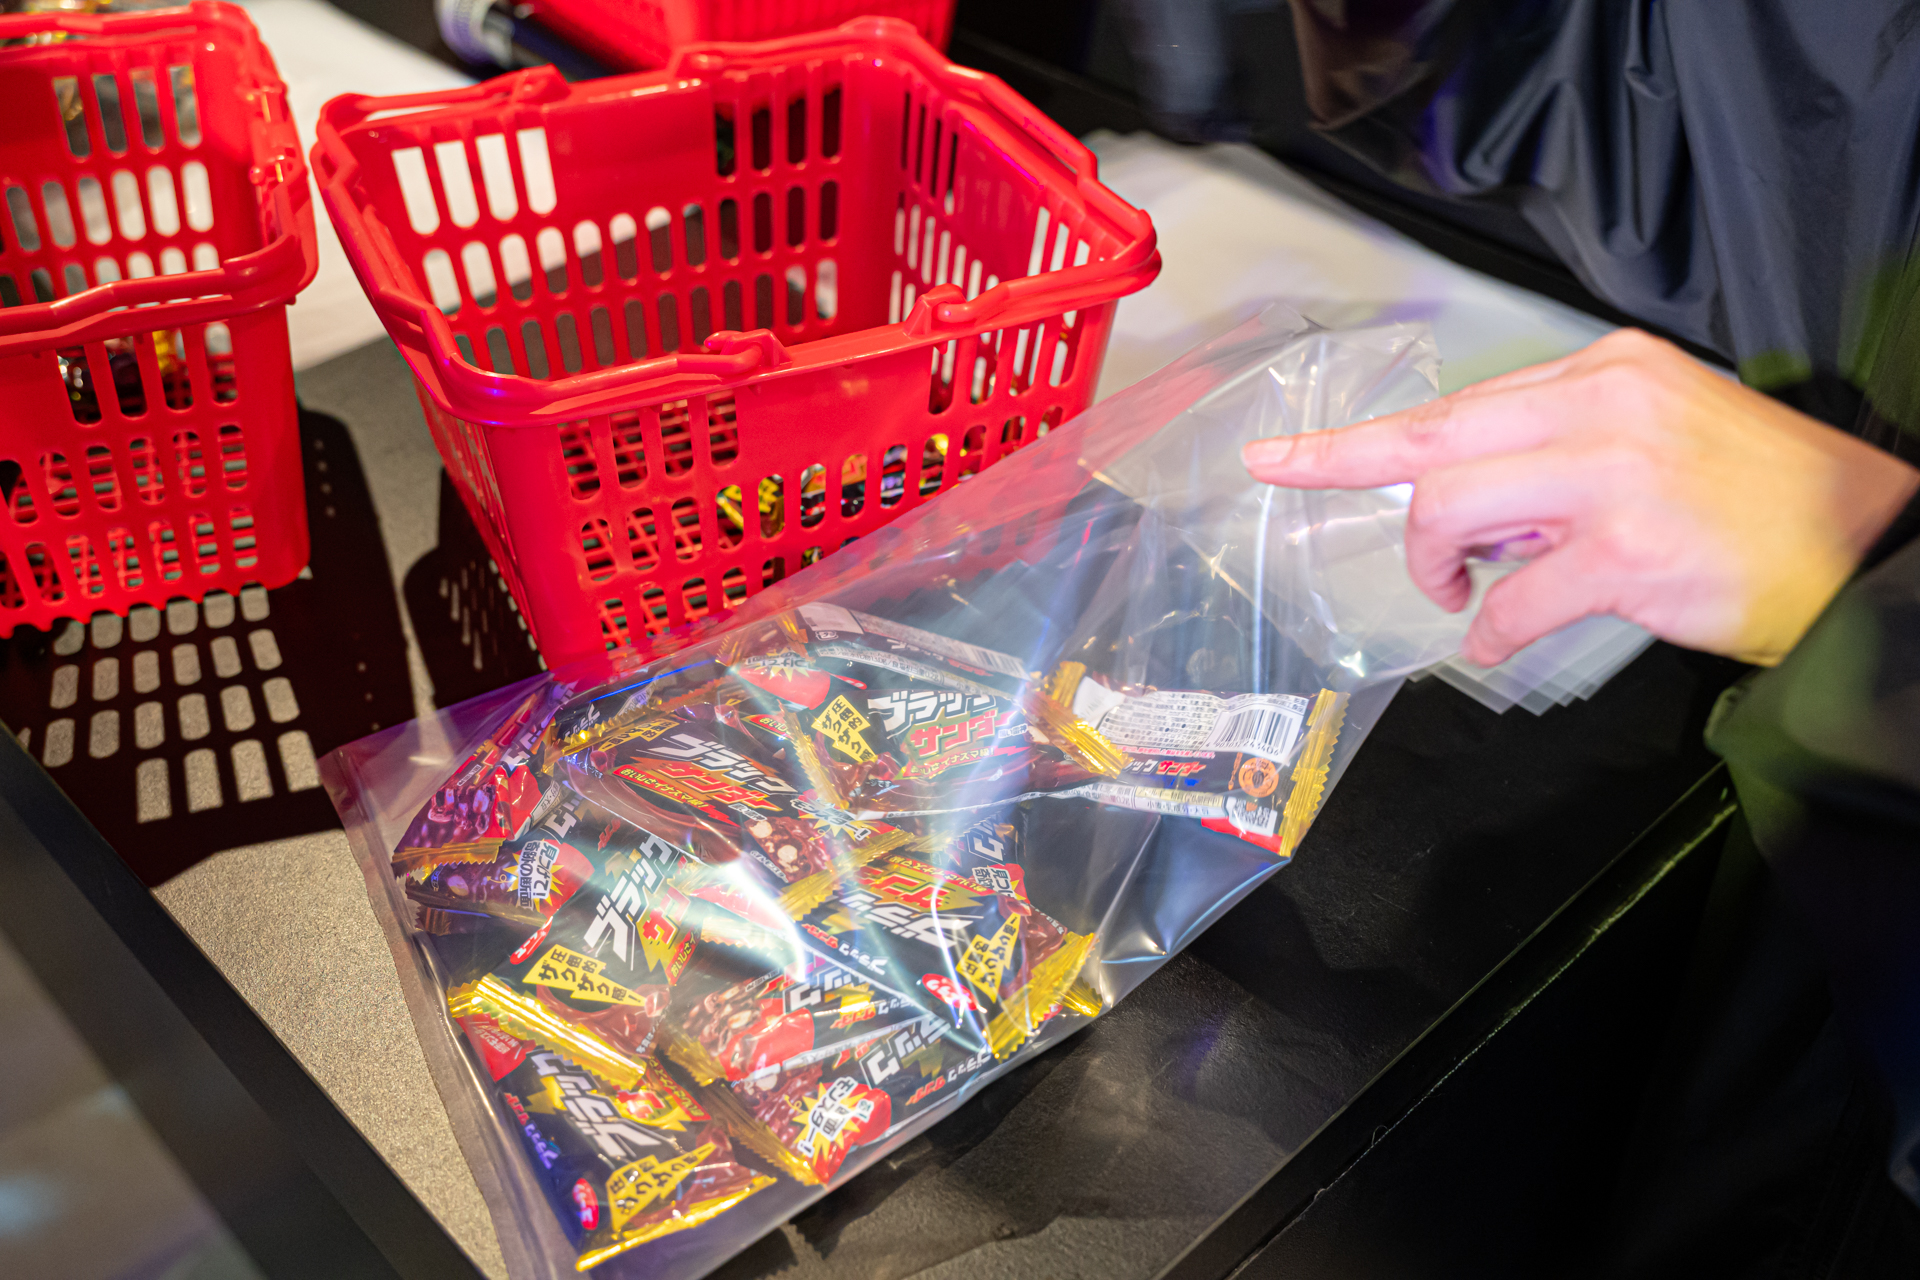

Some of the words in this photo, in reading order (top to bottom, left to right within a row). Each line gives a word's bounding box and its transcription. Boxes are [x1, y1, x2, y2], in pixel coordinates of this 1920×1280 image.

[647, 733, 798, 794] ブラック
[520, 841, 541, 908] 奇跡の断面
[533, 841, 556, 897] 見つけて!
[583, 835, 675, 963] ブラック
[840, 887, 973, 948] ブラッ
[866, 1015, 951, 1087] ラック
[531, 1052, 662, 1158] ブラック
